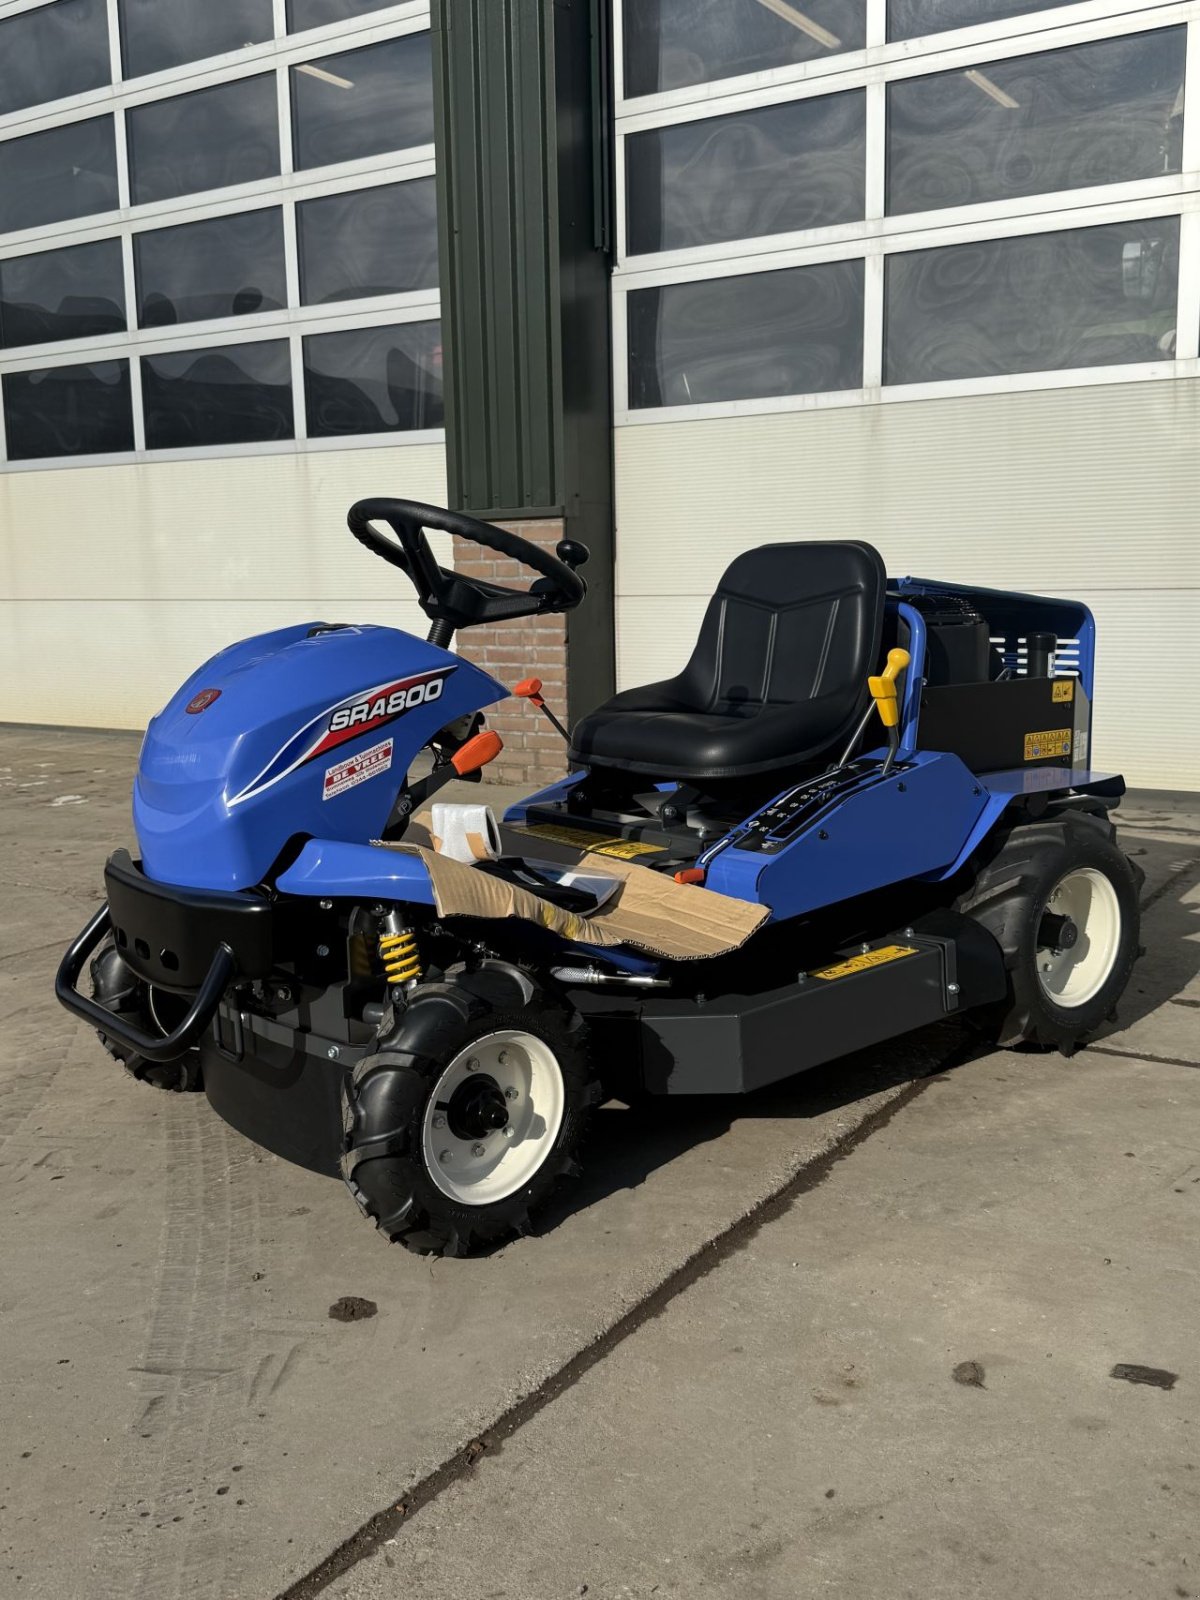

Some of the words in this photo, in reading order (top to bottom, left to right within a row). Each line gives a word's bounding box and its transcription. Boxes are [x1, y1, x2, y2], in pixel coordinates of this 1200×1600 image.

[328, 678, 444, 732] SRA800
[333, 770, 349, 782] DE
[354, 752, 385, 770] VREE
